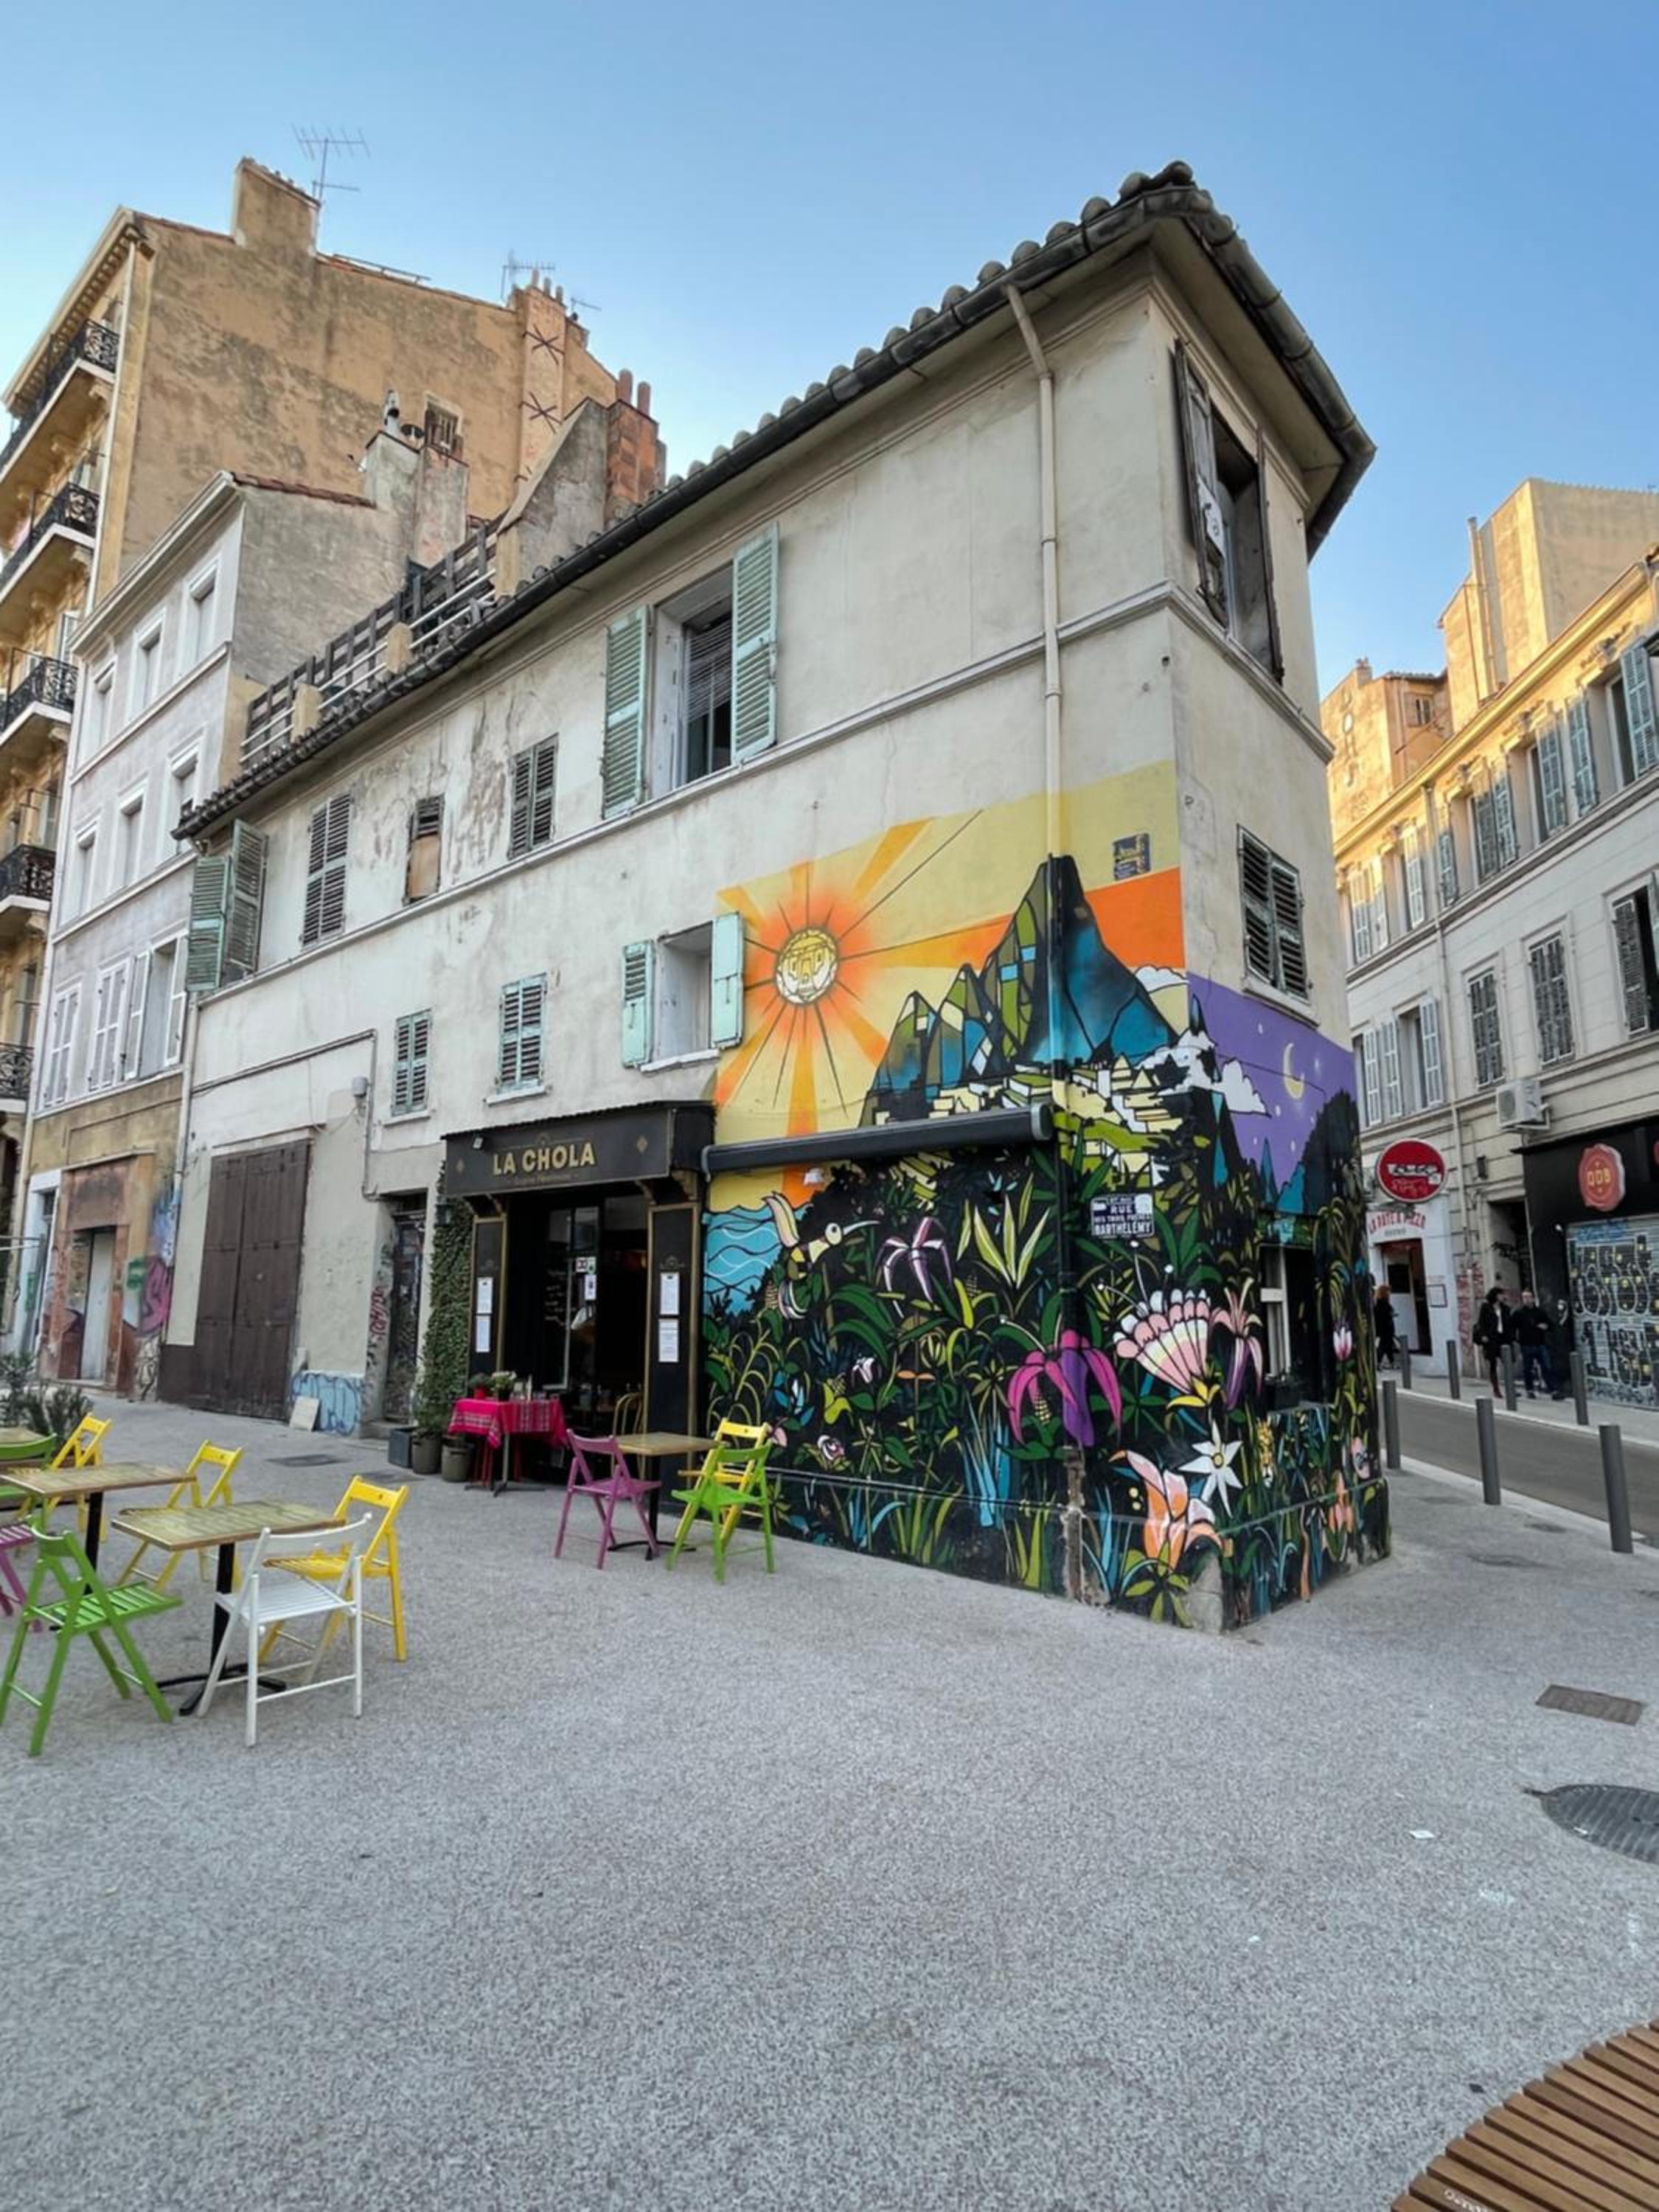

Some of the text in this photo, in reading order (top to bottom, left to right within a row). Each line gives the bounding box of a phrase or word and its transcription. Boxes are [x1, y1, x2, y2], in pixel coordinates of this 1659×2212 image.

[493, 1142, 595, 1175] LA CHOLA
[1110, 1205, 1133, 1214] RUE
